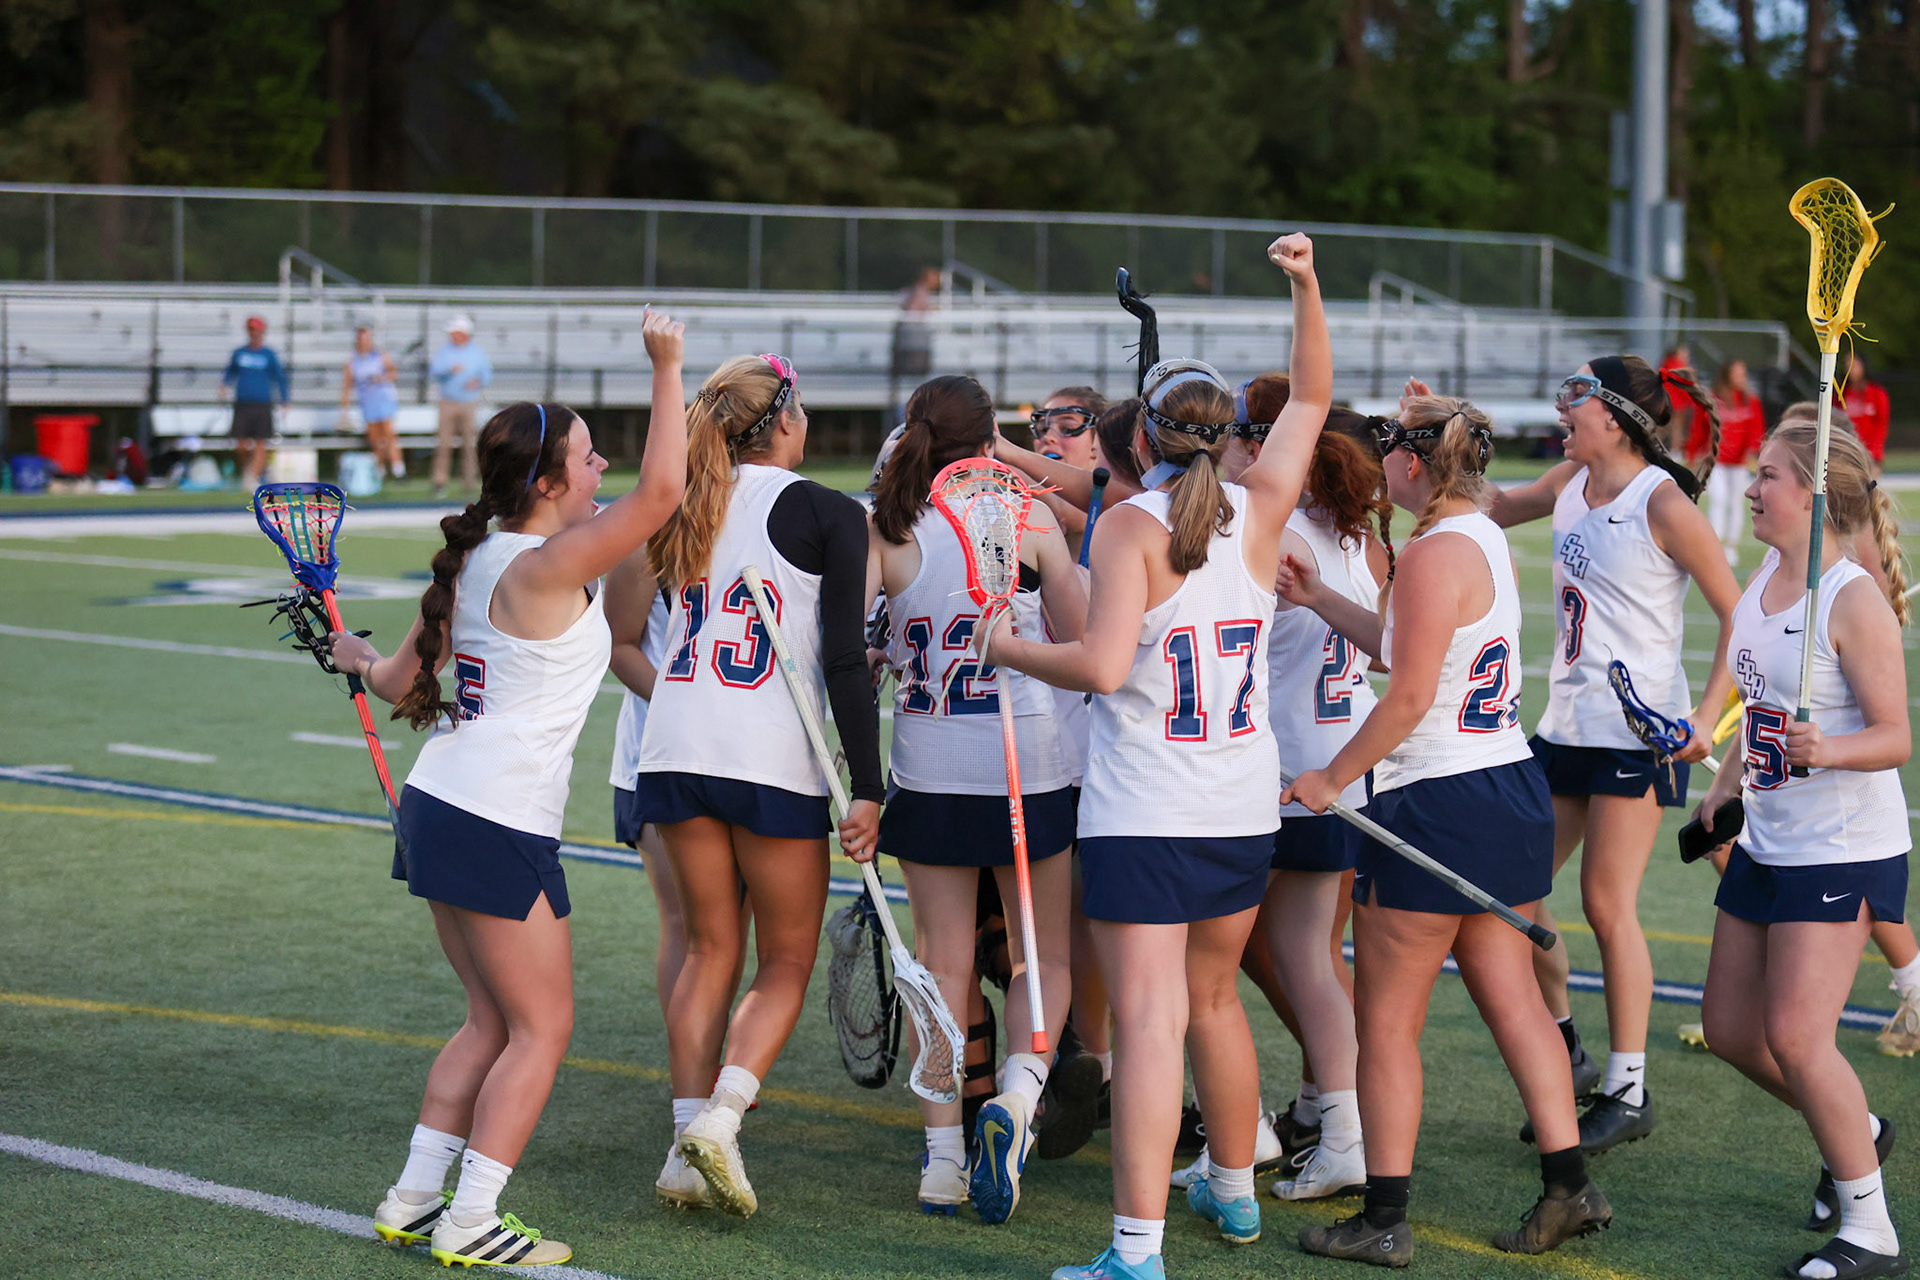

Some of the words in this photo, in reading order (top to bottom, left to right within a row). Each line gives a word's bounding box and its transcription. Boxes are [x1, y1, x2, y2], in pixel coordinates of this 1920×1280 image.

[774, 384, 789, 408] STX
[1602, 391, 1624, 408] STX
[750, 411, 773, 435] STX
[1152, 412, 1177, 430] STX
[1632, 409, 1649, 428] STX
[1406, 428, 1435, 439] STX
[1560, 533, 1590, 580] SBA
[287, 605, 307, 633] STX
[664, 576, 783, 690] 13
[1562, 586, 1587, 666] 3
[308, 636, 327, 660] STX
[903, 613, 1001, 716] 12
[1737, 648, 1766, 700] SBA
[1163, 619, 1262, 742] 17
[1746, 707, 1789, 790] 5
